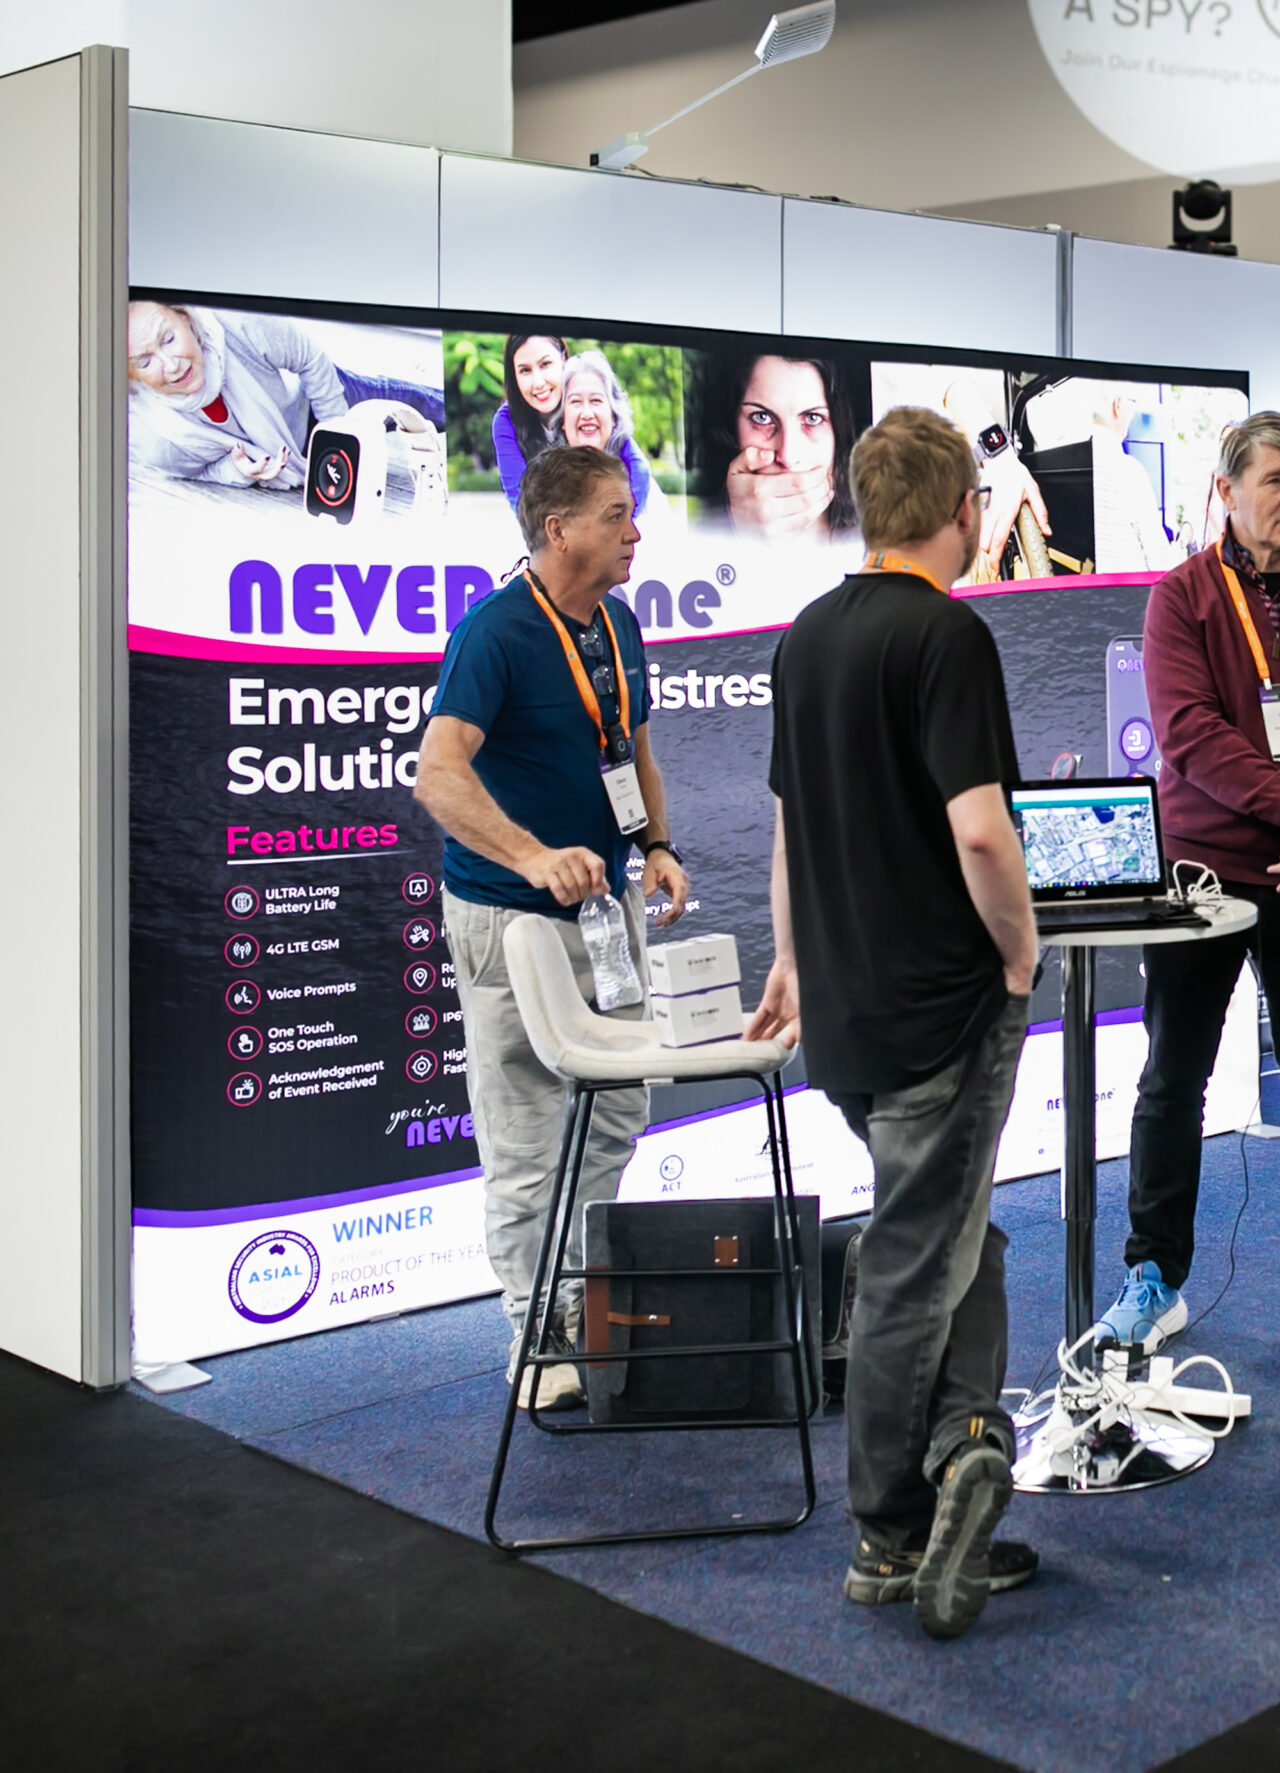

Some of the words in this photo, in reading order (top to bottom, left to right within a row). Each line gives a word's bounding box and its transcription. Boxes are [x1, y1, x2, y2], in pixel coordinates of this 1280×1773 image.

[229, 678, 437, 733] Emerg
[649, 663, 772, 711] istres
[227, 739, 419, 796] Solutio
[227, 823, 398, 854] Features
[265, 887, 306, 900] ULTRA
[309, 886, 340, 898] Long
[265, 902, 311, 914] Battery
[314, 899, 337, 911] Life
[266, 944, 284, 955] 4G
[287, 941, 309, 953] LTE
[311, 938, 339, 951] GSM
[267, 988, 301, 1000] Voice
[304, 982, 356, 997] Prompts
[268, 1027, 294, 1038] One
[297, 1021, 334, 1036] Touch
[268, 1041, 294, 1054] SOS
[297, 1034, 358, 1051] Operation
[268, 1060, 384, 1085] Acknowledgement
[268, 1088, 282, 1099] of
[284, 1083, 319, 1098] Event
[323, 1075, 377, 1092] Received
[385, 1099, 448, 1135] you're
[661, 1181, 681, 1193] ACT
[333, 1206, 433, 1243] WINNER
[248, 1264, 303, 1284] ASIAL
[331, 1259, 402, 1285] PRODUCT
[405, 1255, 424, 1271] OF
[430, 1249, 453, 1265] THE
[458, 1243, 485, 1259] YEA
[329, 1280, 395, 1306] ALARMS
